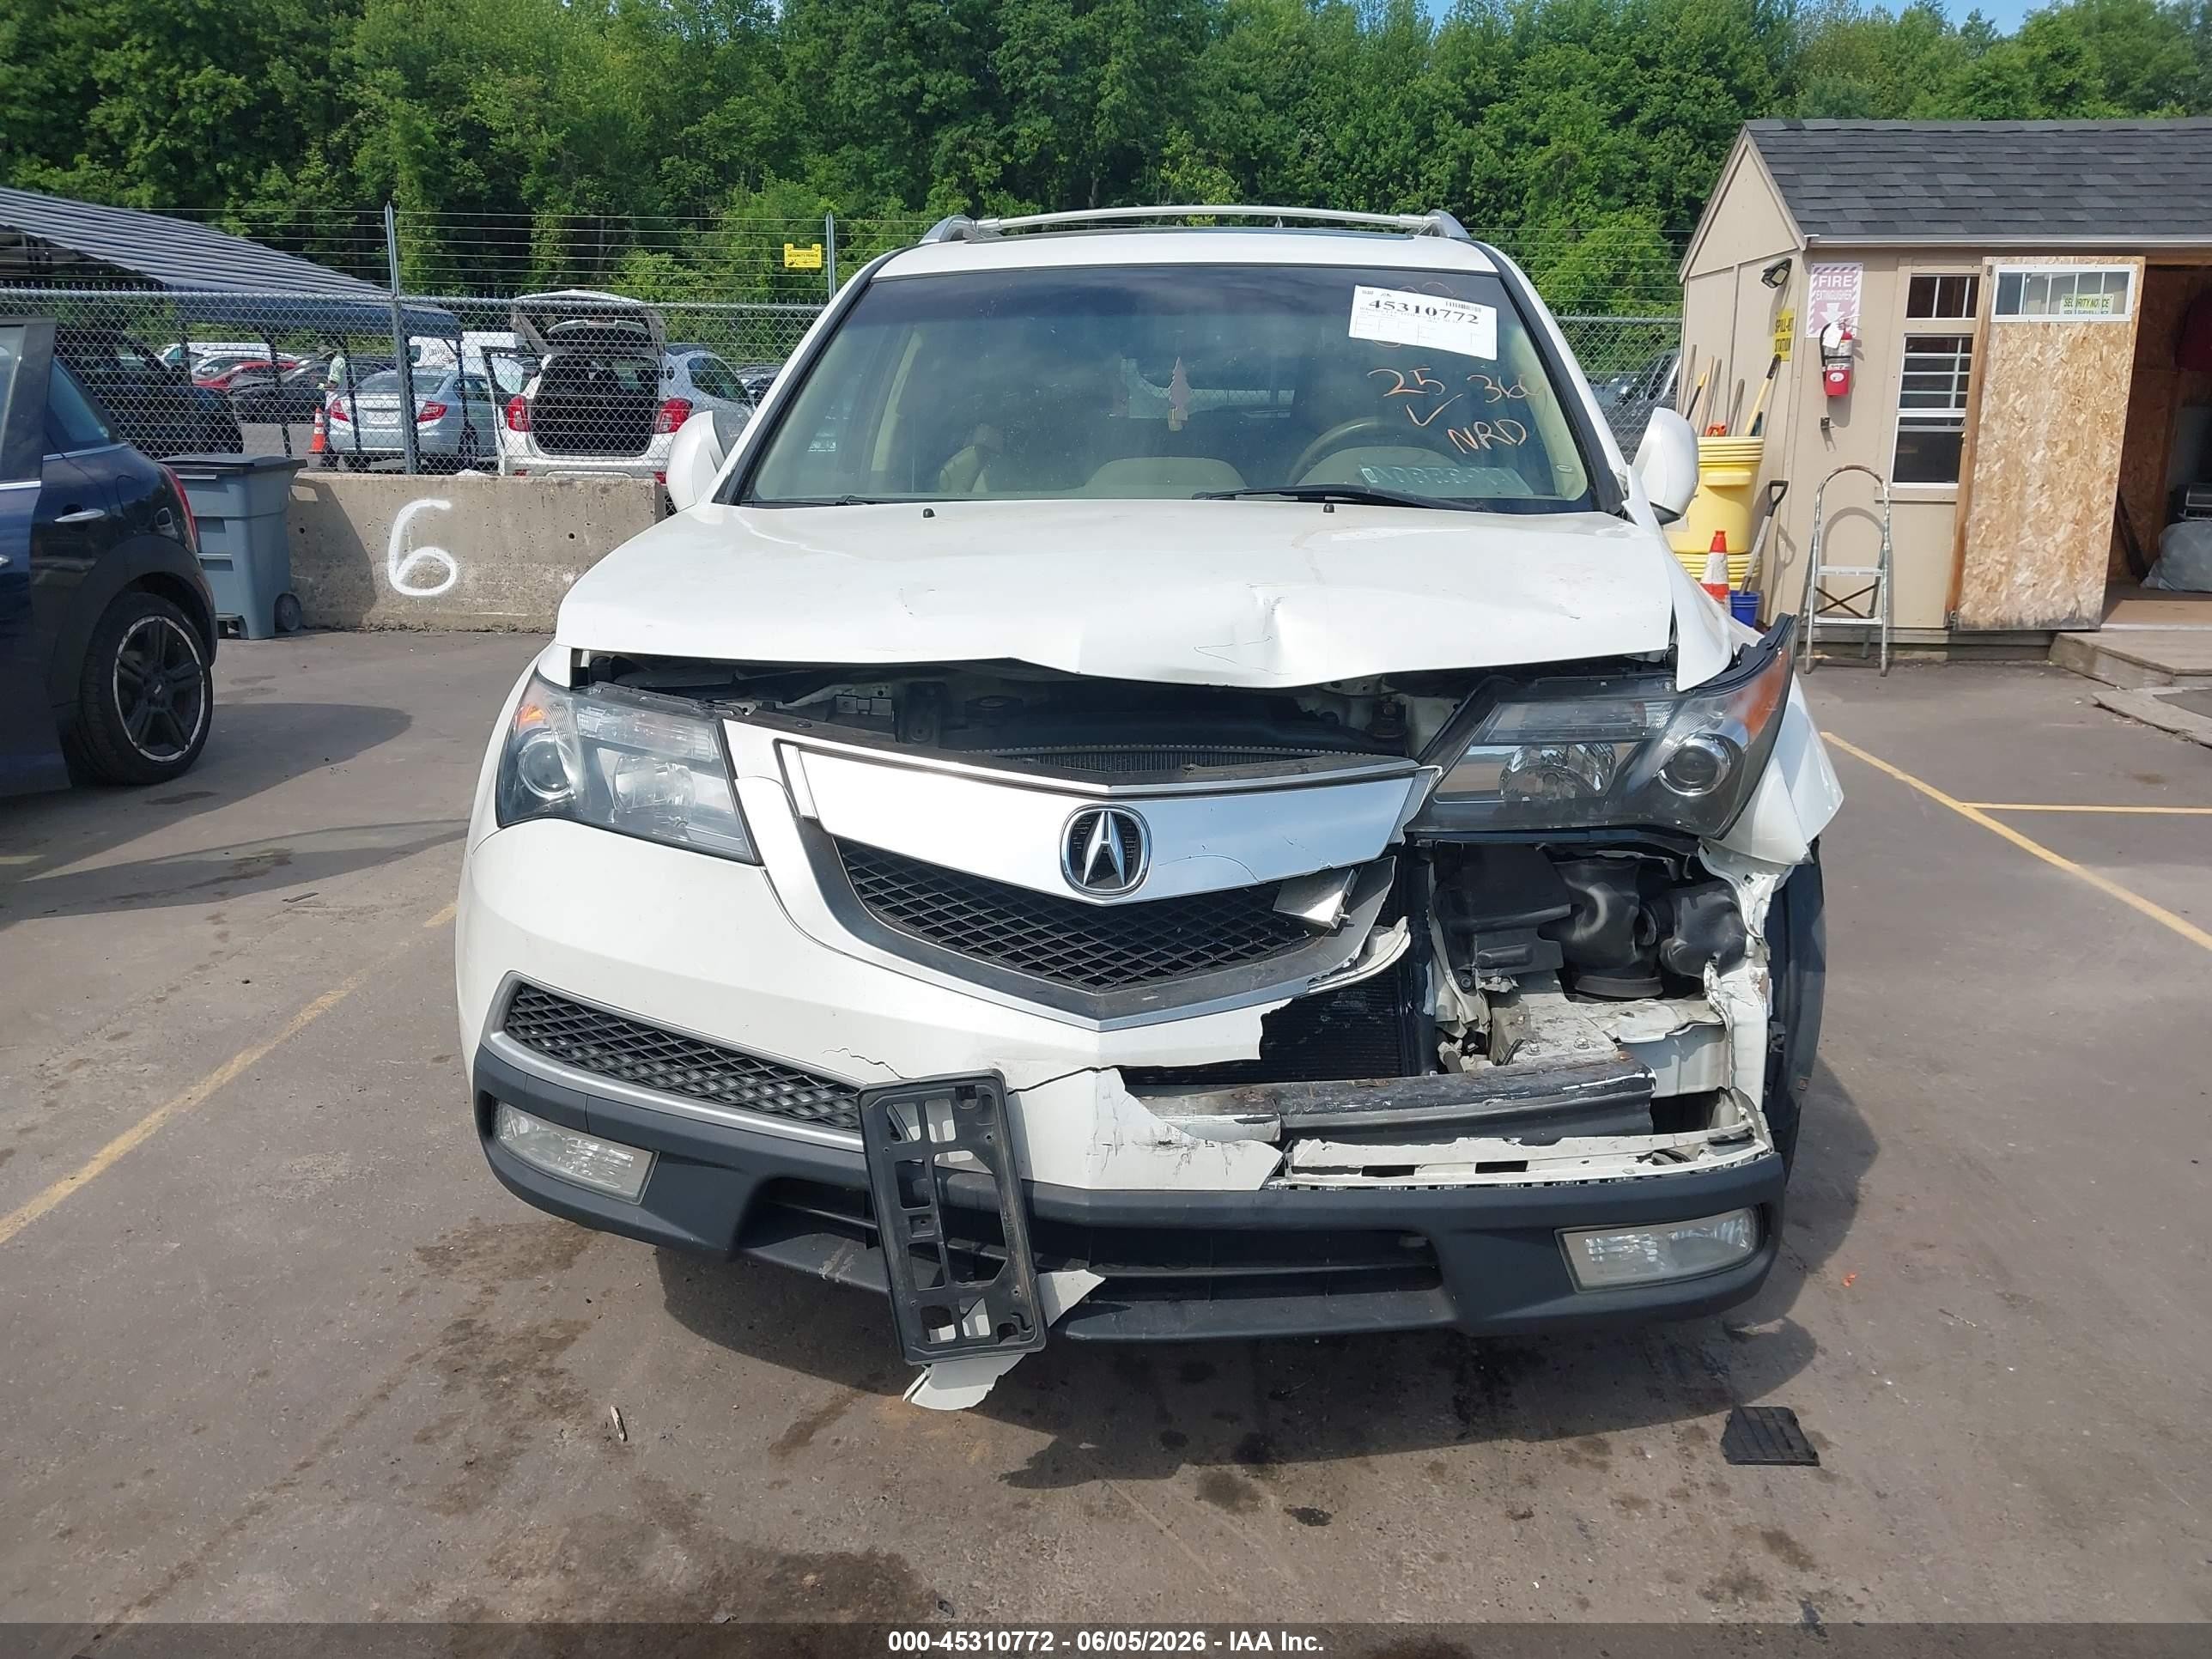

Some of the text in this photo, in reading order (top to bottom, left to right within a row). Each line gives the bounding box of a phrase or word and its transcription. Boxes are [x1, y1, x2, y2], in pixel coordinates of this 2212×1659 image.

[1819, 275, 1853, 288] FIRE
[1815, 289, 1852, 301] EXTINGUISHER
[2090, 297, 2110, 308] NOTCE
[1368, 300, 1480, 325] 45310772
[1774, 337, 1792, 352] STATION
[1366, 367, 1447, 398] 25
[1446, 418, 1528, 455] NRD
[388, 499, 457, 596] 6
